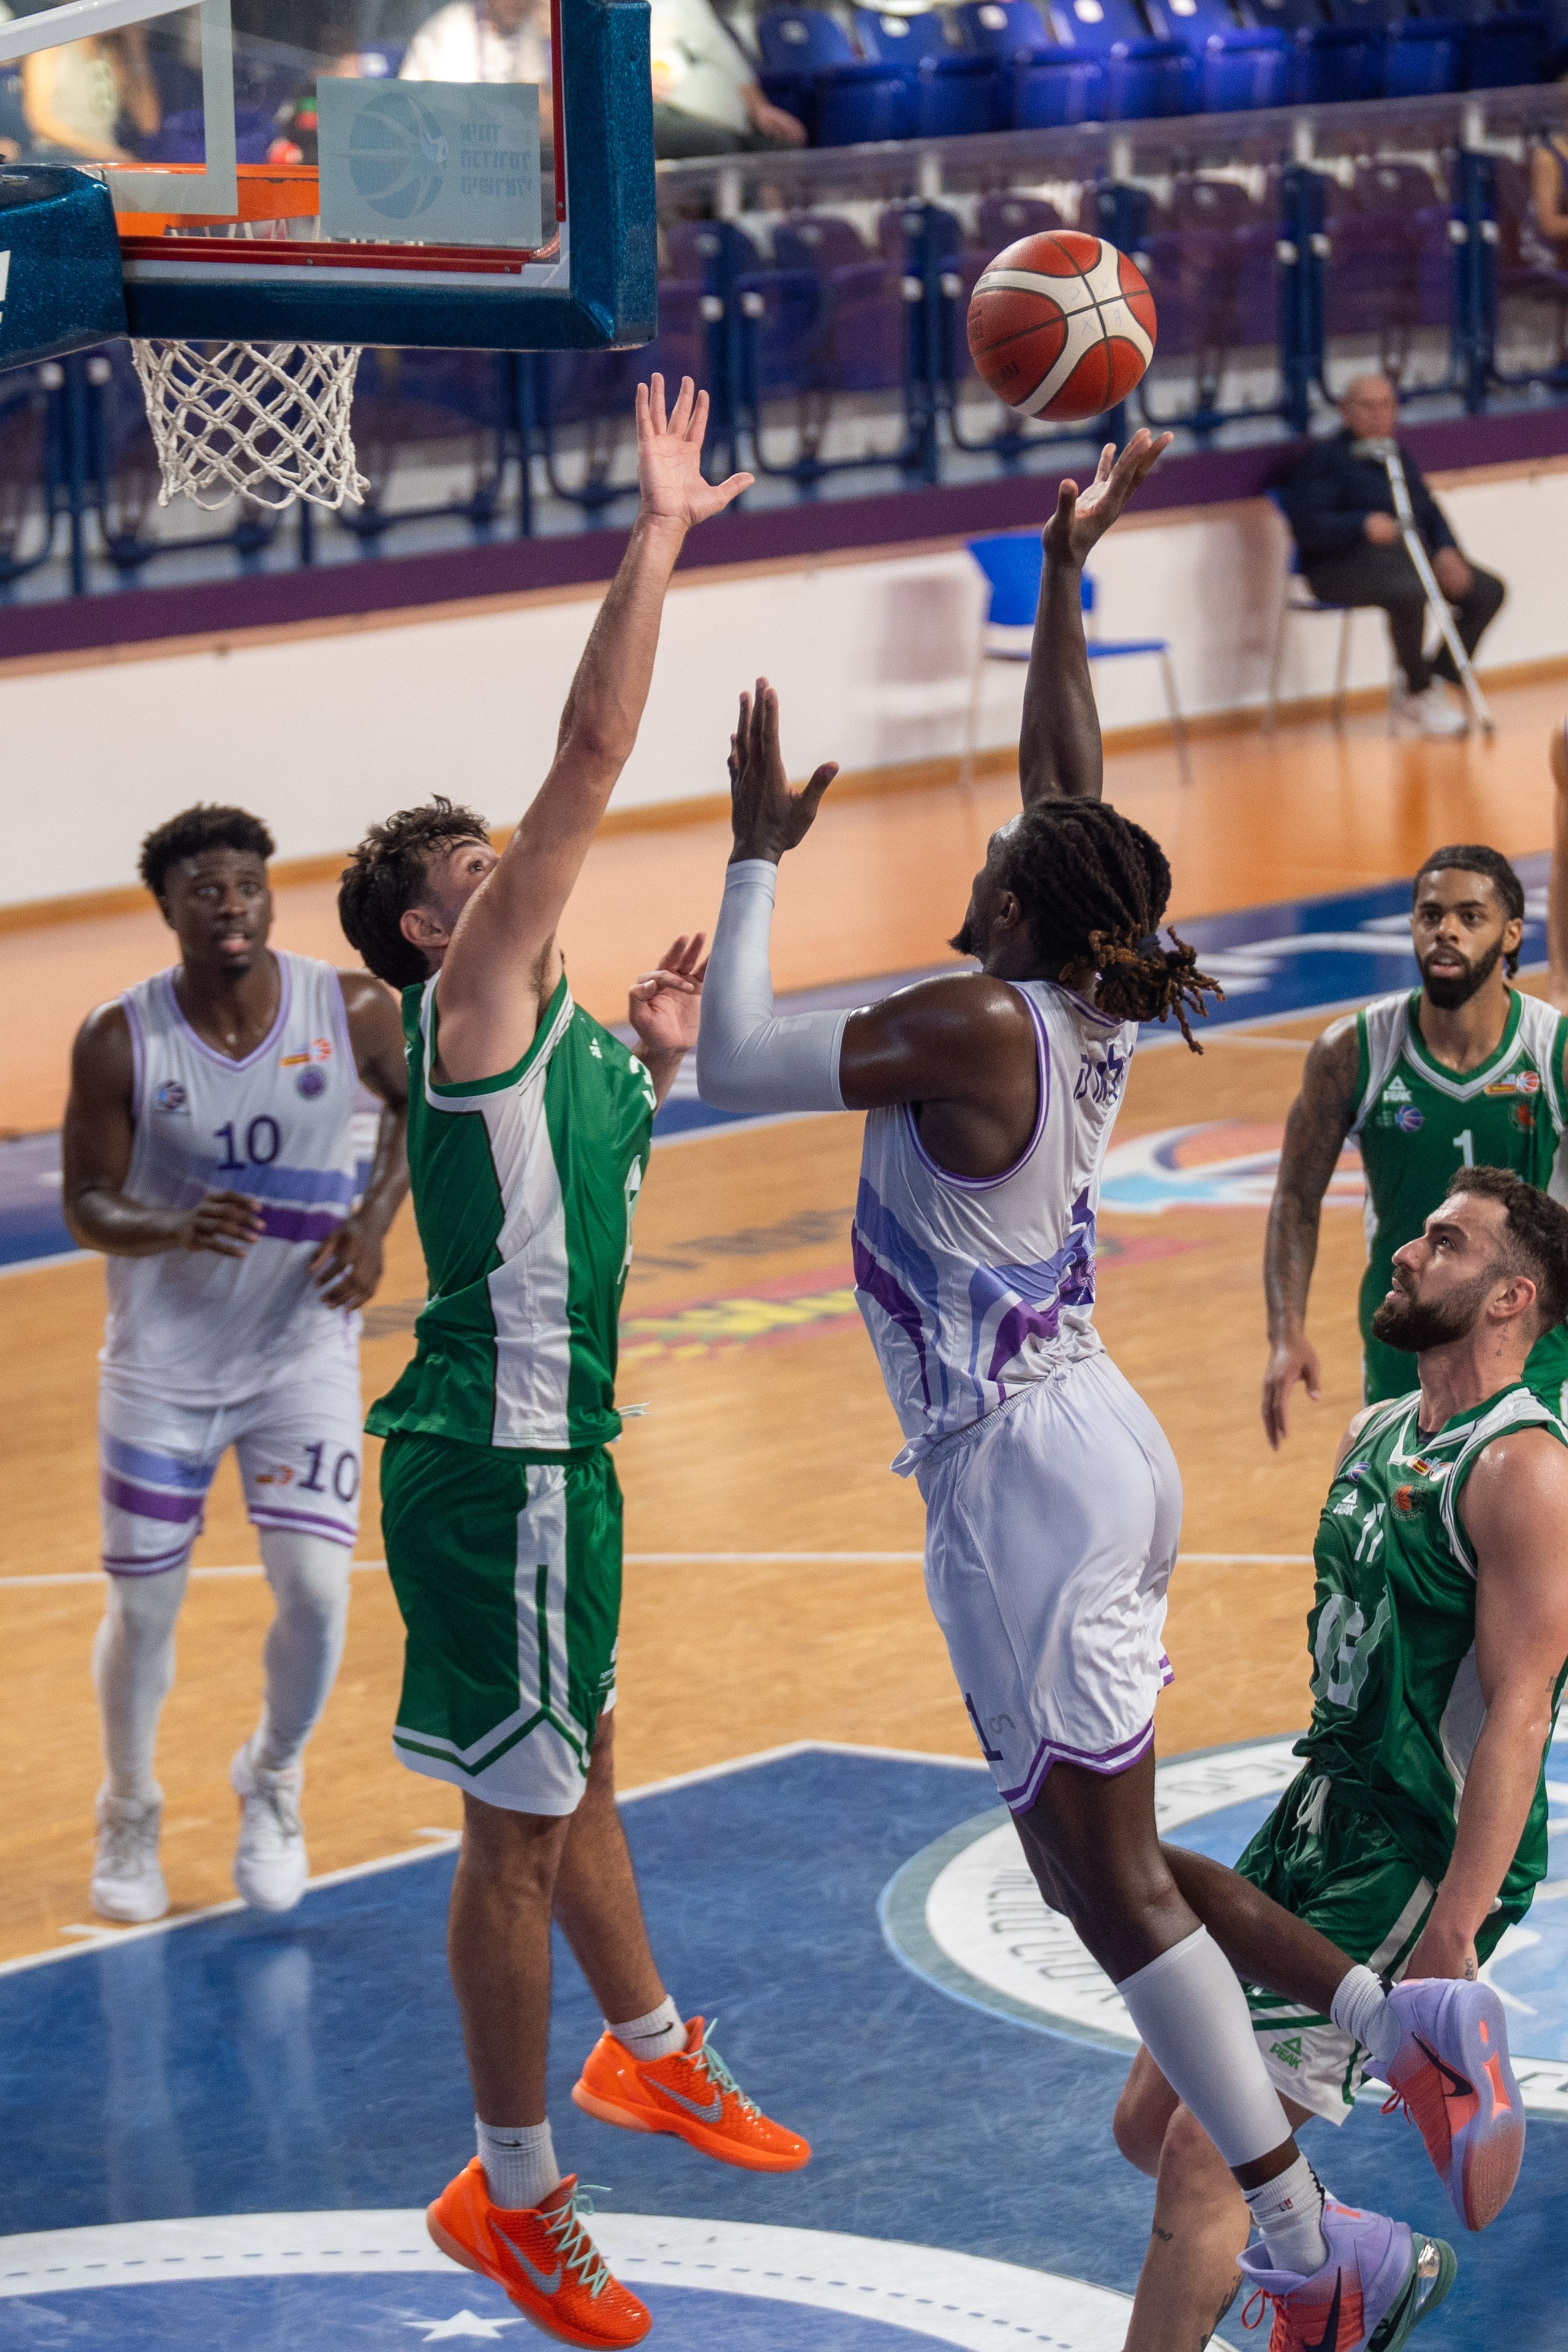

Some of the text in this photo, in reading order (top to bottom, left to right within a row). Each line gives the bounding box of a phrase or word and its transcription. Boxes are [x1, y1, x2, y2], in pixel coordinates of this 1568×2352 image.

[214, 1112, 281, 1170] 10
[298, 1441, 360, 1502] 10
[1269, 2042, 1304, 2070] PEAK
